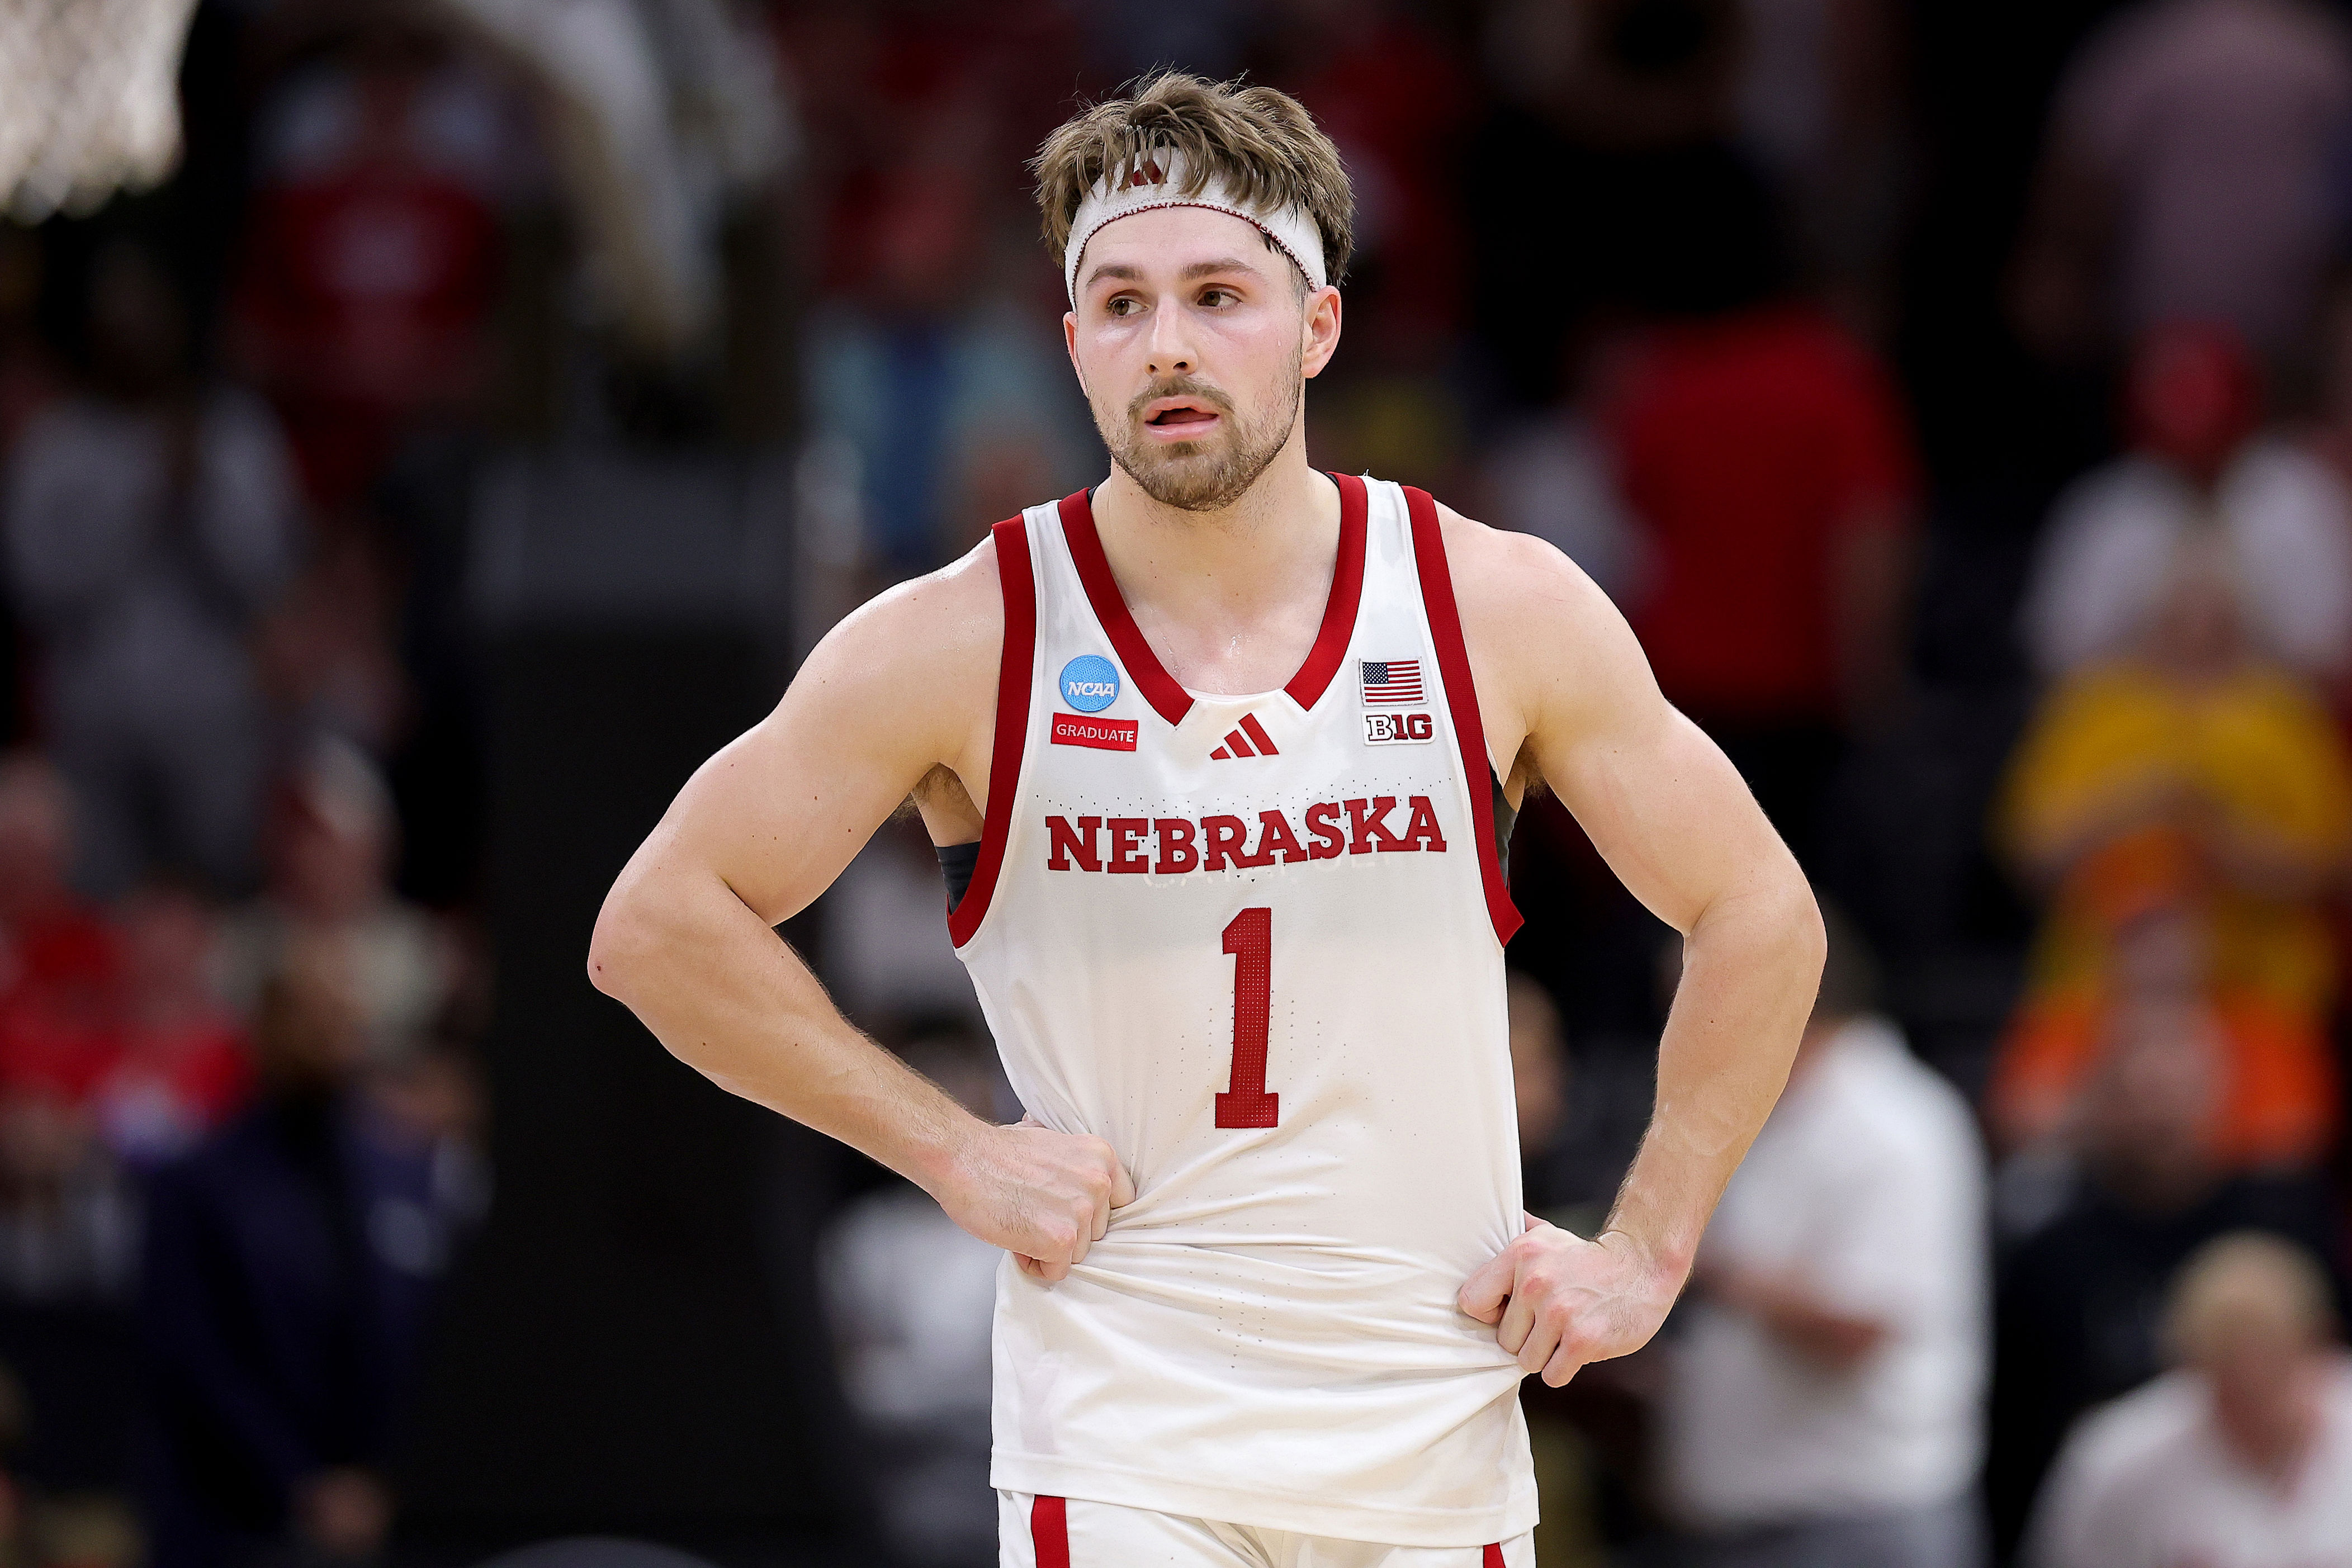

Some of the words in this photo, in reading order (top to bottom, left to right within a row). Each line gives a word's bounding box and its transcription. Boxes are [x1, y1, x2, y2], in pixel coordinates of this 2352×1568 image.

[1068, 681, 1115, 697] NCAA
[1056, 724, 1134, 742] GRADUATE
[1045, 796, 1447, 874] NEBRASKA
[1215, 907, 1279, 1129] 1
